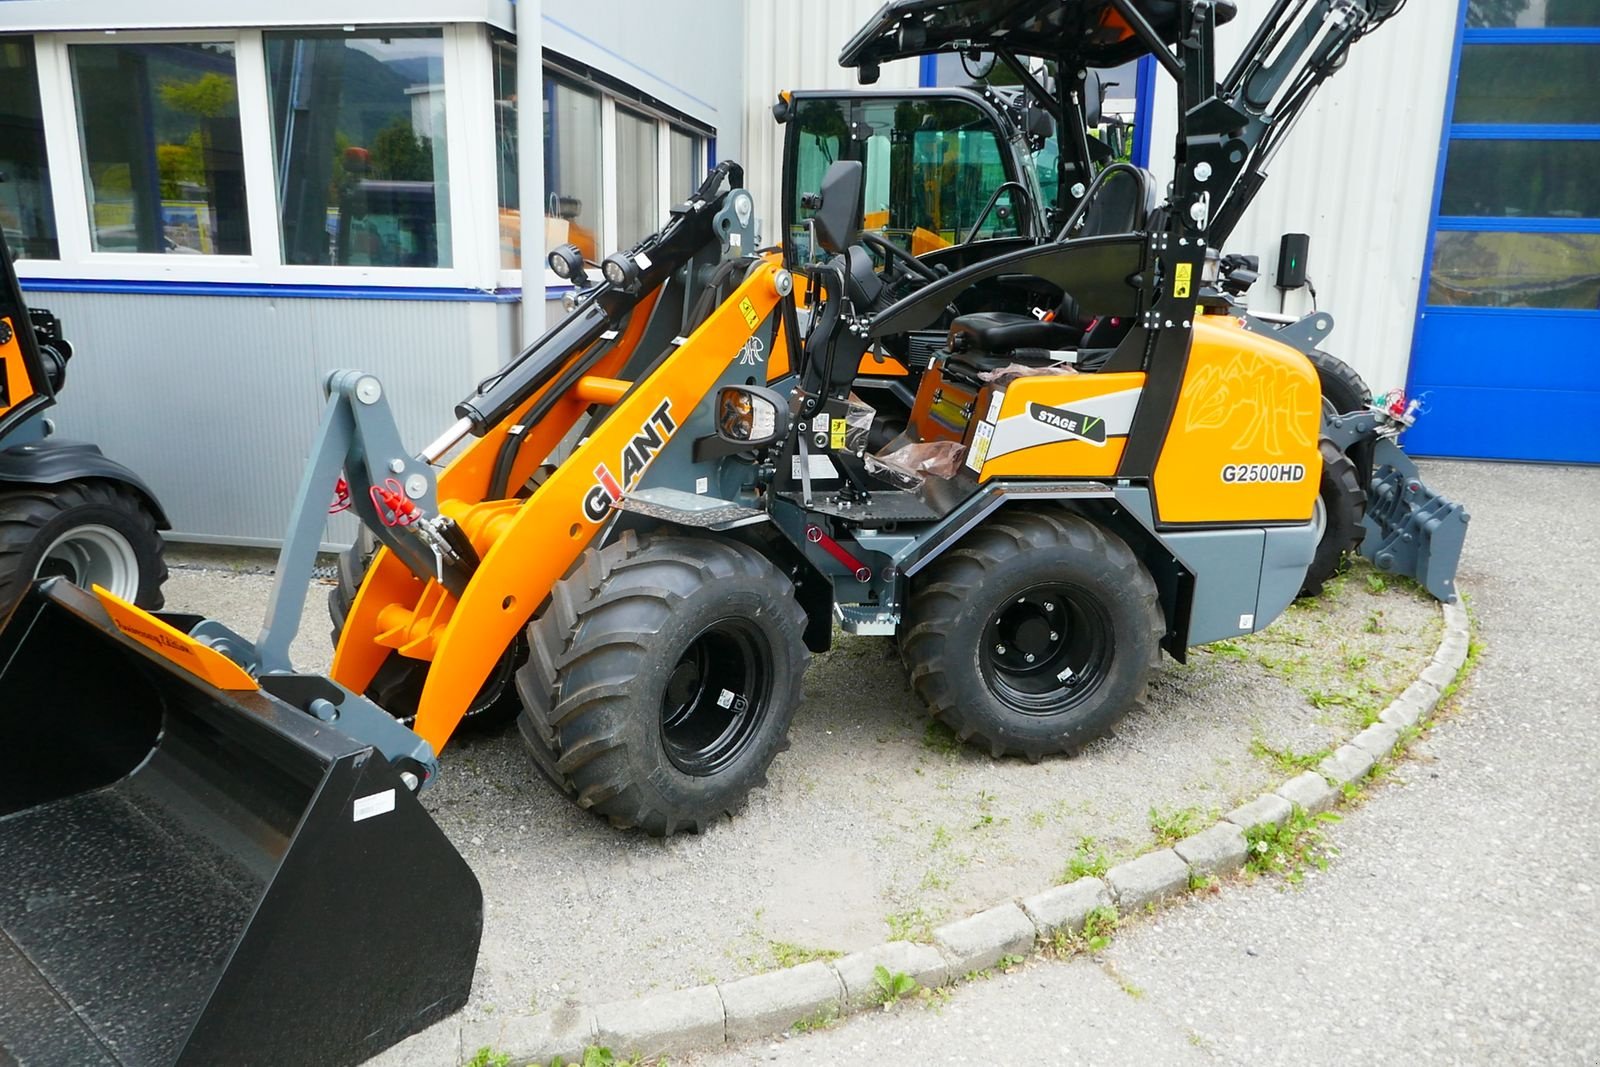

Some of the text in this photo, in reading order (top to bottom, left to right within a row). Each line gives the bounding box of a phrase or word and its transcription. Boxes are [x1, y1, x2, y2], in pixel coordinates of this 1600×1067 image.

[1038, 410, 1101, 435] STAGE V
[1222, 464, 1304, 482] G2500HD
